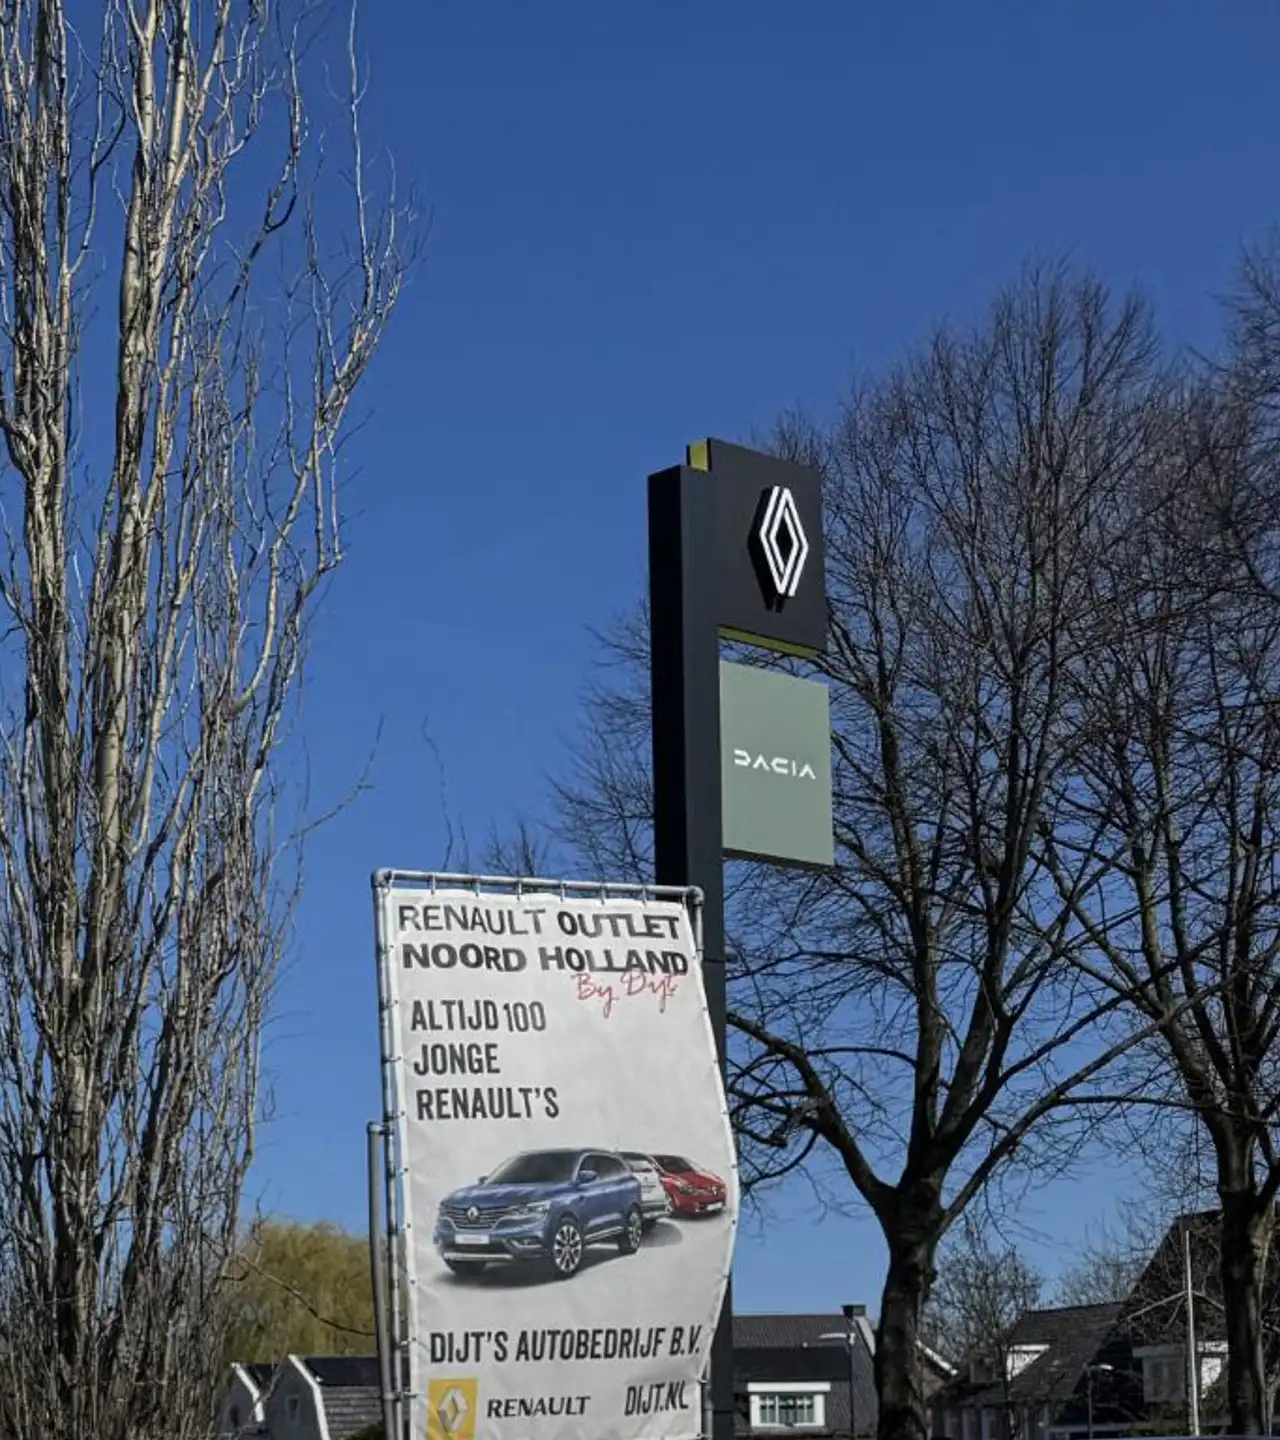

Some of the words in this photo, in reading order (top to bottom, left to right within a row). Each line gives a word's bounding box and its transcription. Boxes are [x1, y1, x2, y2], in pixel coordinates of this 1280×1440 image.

[734, 749, 816, 780] DACIA
[399, 905, 545, 936] RENAULT
[557, 911, 679, 940] OUTLET
[403, 943, 527, 972] NOORD
[539, 947, 689, 976] HOLLAND
[410, 1000, 498, 1031] ALTIJD
[504, 1001, 546, 1032] 100
[413, 1043, 501, 1075] JONGE
[416, 1087, 559, 1120] RENAULT'S
[429, 1331, 508, 1363] DIJT'S
[516, 1327, 666, 1361] AUTOBEDRIJF
[670, 1325, 702, 1357] B.V.
[487, 1396, 590, 1418] RENAULT
[624, 1381, 689, 1416] DIJT.NL
